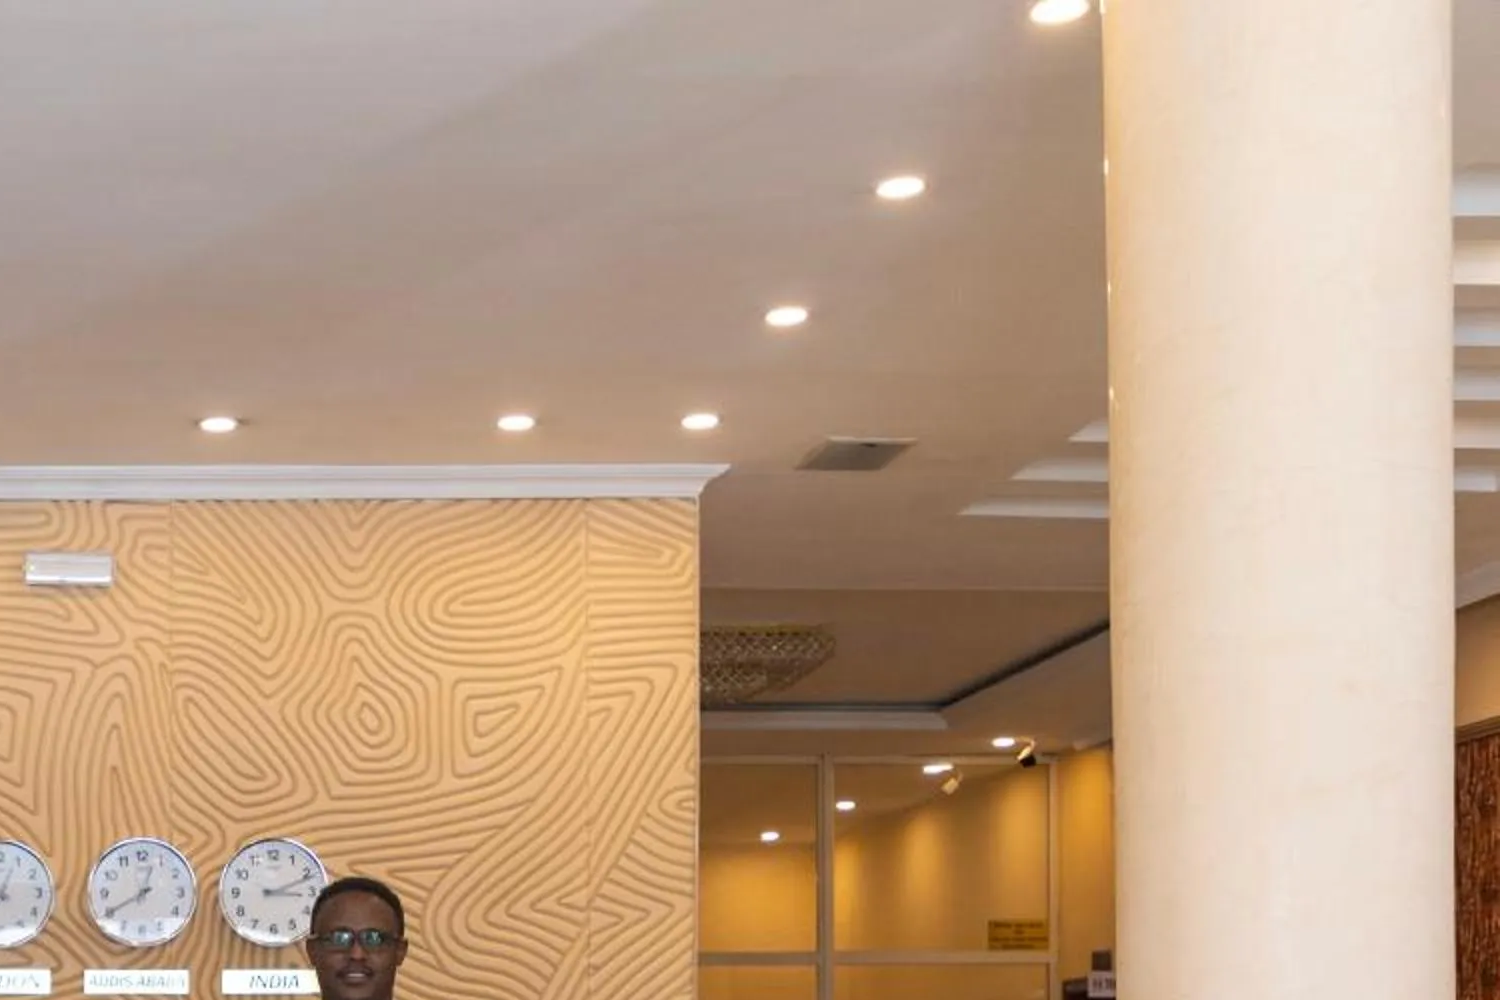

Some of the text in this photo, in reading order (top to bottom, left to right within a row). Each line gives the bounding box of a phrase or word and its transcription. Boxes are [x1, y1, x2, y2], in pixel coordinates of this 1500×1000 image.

[136, 850, 148, 862] 12
[267, 849, 279, 860] 12
[289, 854, 295, 865] 1
[119, 855, 128, 867] 11
[236, 868, 249, 880] 10
[100, 887, 109, 900] 9
[177, 886, 185, 899] 3
[231, 887, 240, 899] 9
[308, 885, 317, 898] 3
[236, 905, 245, 917] 8
[250, 918, 259, 929] 7
[270, 923, 278, 935] 6
[289, 918, 296, 930] 5
[248, 974, 299, 989] INDIA
